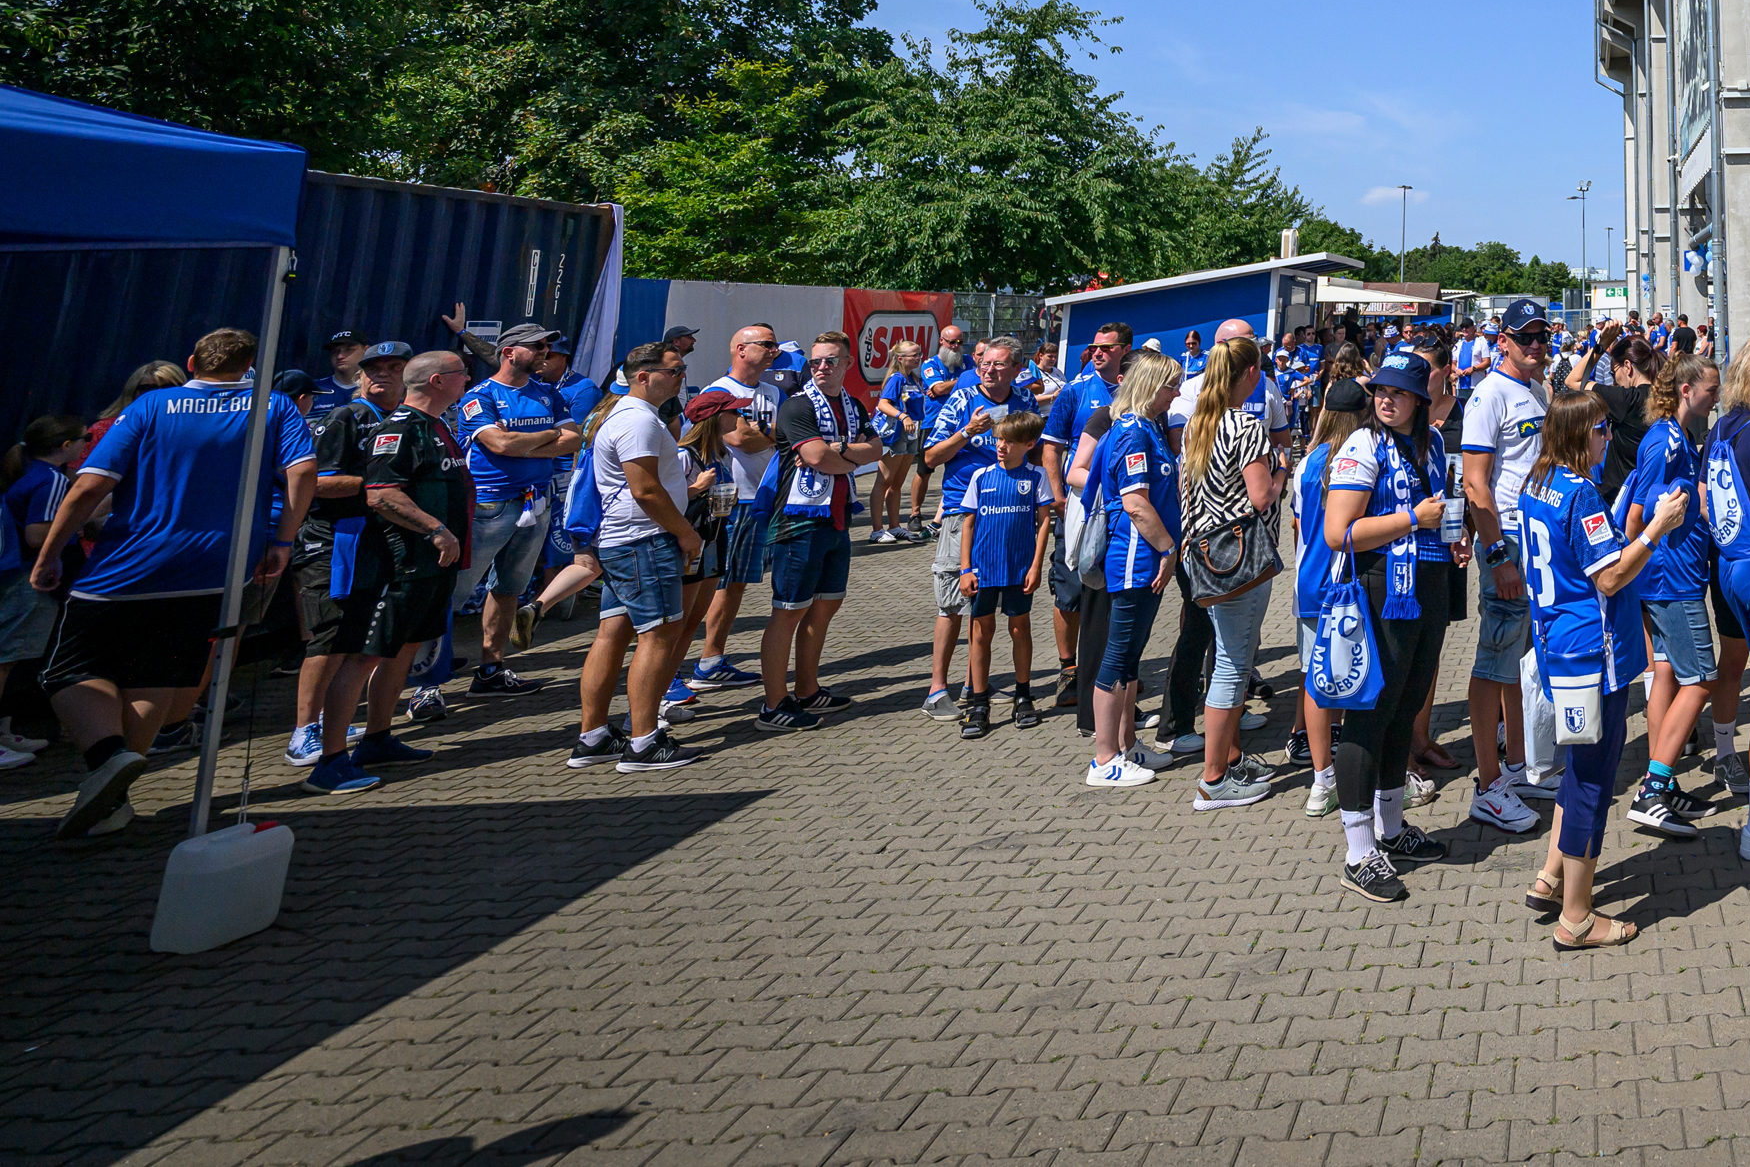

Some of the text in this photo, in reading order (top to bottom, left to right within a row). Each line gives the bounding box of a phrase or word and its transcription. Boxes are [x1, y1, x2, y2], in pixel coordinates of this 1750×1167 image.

[553, 253, 566, 315] 22G1
[331, 331, 351, 341] NYC
[864, 327, 873, 369] radio
[166, 395, 272, 414] MAGDEBU
[1514, 399, 1531, 408] uhlsport
[510, 416, 555, 427] Humanas
[988, 503, 1031, 514] Humanas
[1313, 642, 1364, 695] MAGDEBURG
